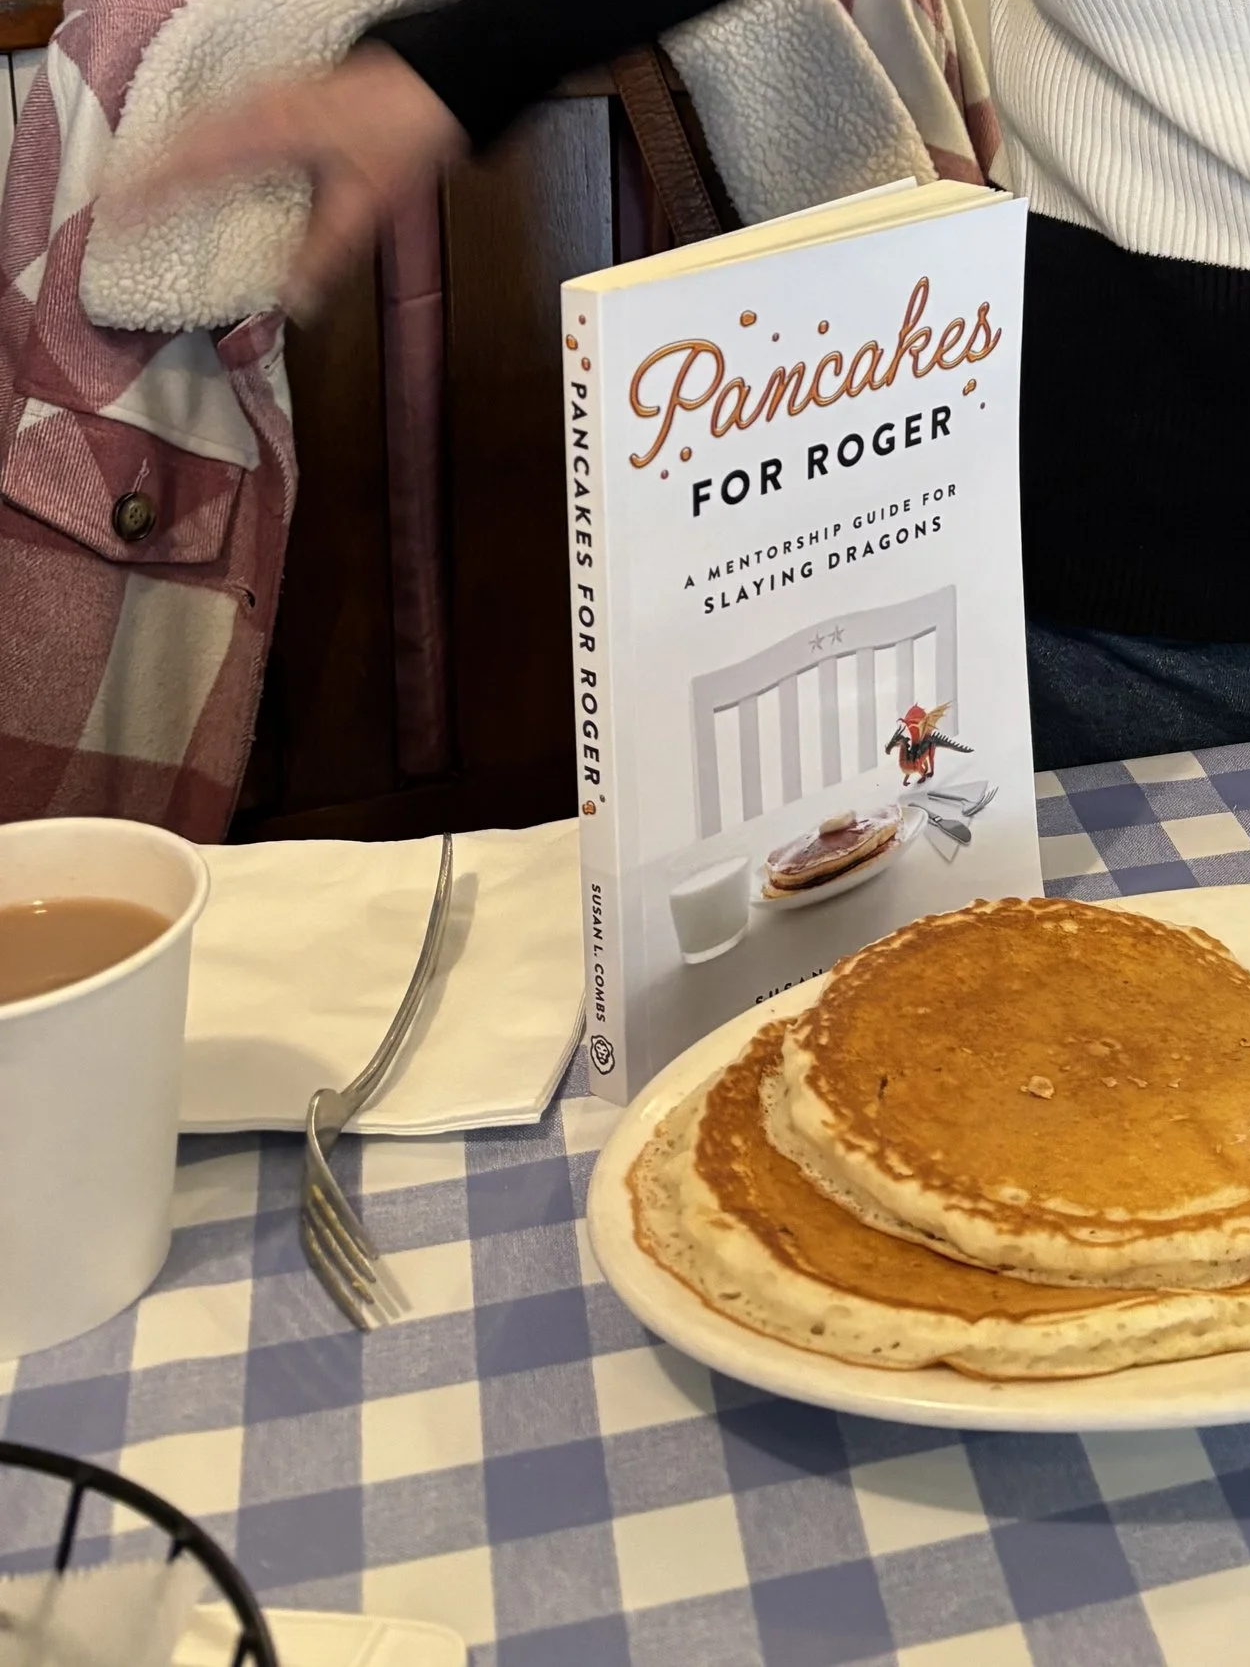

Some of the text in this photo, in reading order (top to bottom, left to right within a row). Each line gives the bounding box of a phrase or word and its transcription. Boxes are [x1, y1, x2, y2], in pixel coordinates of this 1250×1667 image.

[629, 276, 1002, 469] Pancakes
[691, 405, 952, 518] FOR ROGER
[571, 381, 601, 786] PANCAKES FOR ROGER
[683, 483, 958, 590] A MENTORSHIP GUIDE FOR
[703, 515, 943, 614] SLAYING DRAGONS
[591, 883, 606, 1023] SUSAN L. COMBS
